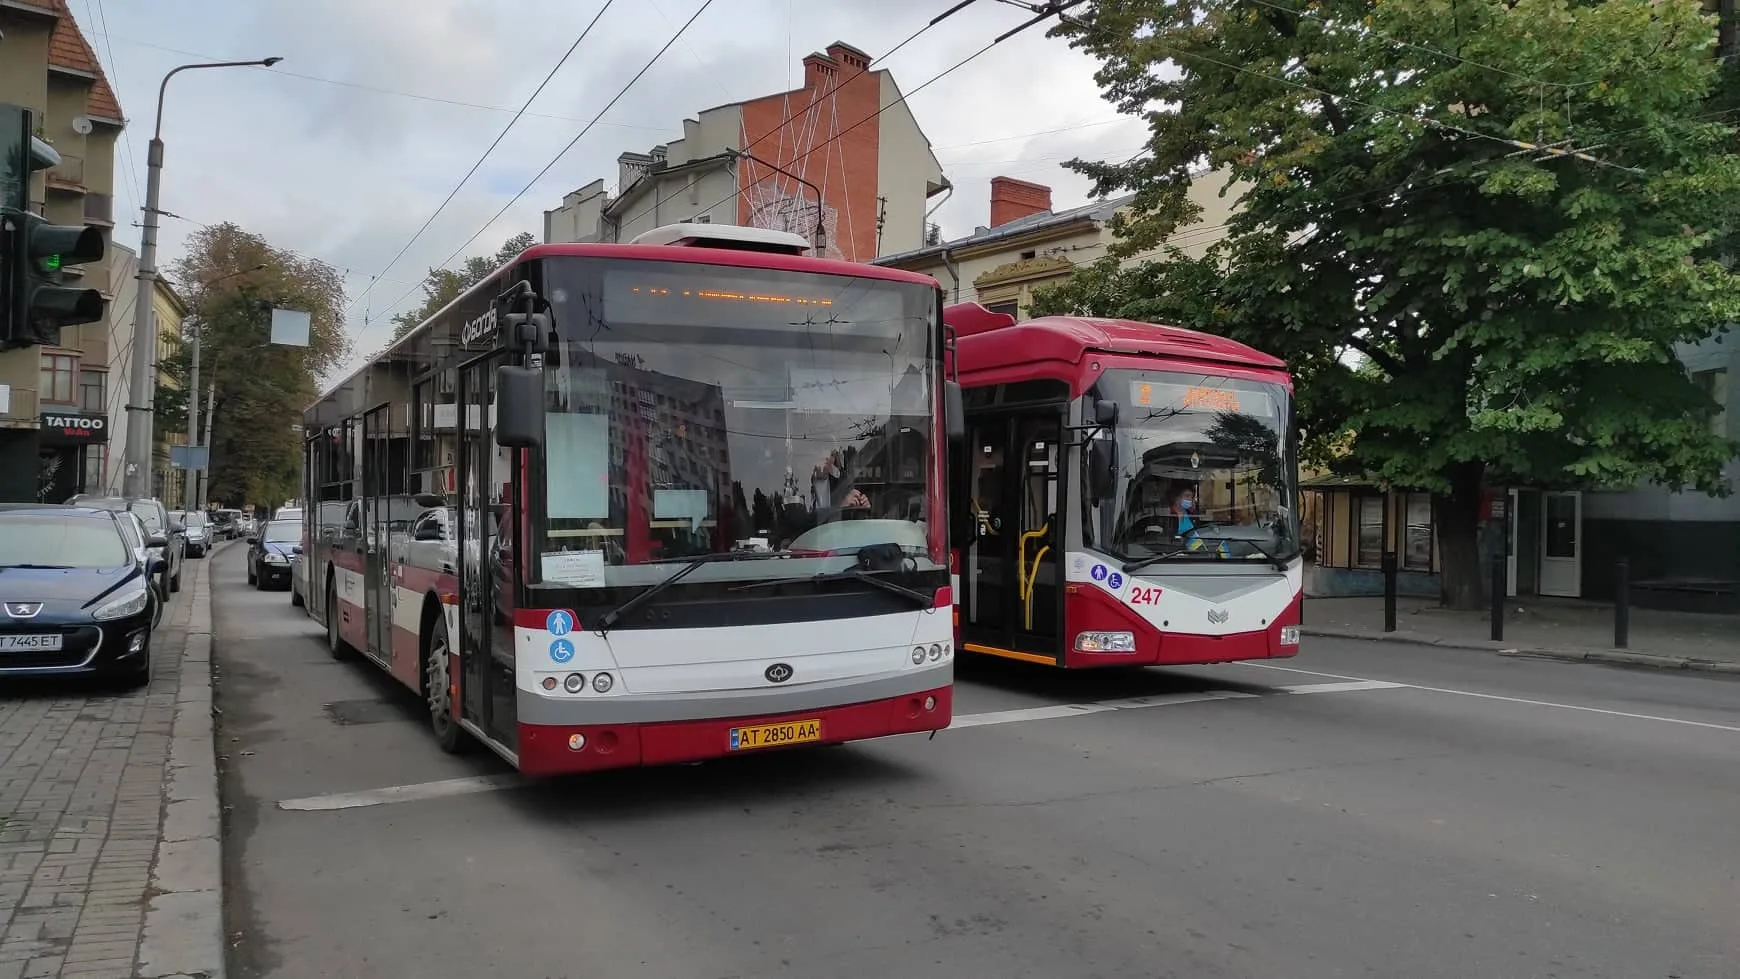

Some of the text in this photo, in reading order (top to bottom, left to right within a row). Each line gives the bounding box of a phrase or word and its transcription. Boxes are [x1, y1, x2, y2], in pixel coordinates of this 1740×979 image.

[471, 308, 497, 341] БОГДА
[46, 416, 103, 430] TATTOO
[1131, 587, 1162, 605] 247
[10, 636, 38, 648] 7445
[41, 636, 59, 647] ET
[740, 724, 816, 745] AT 2850 AA
